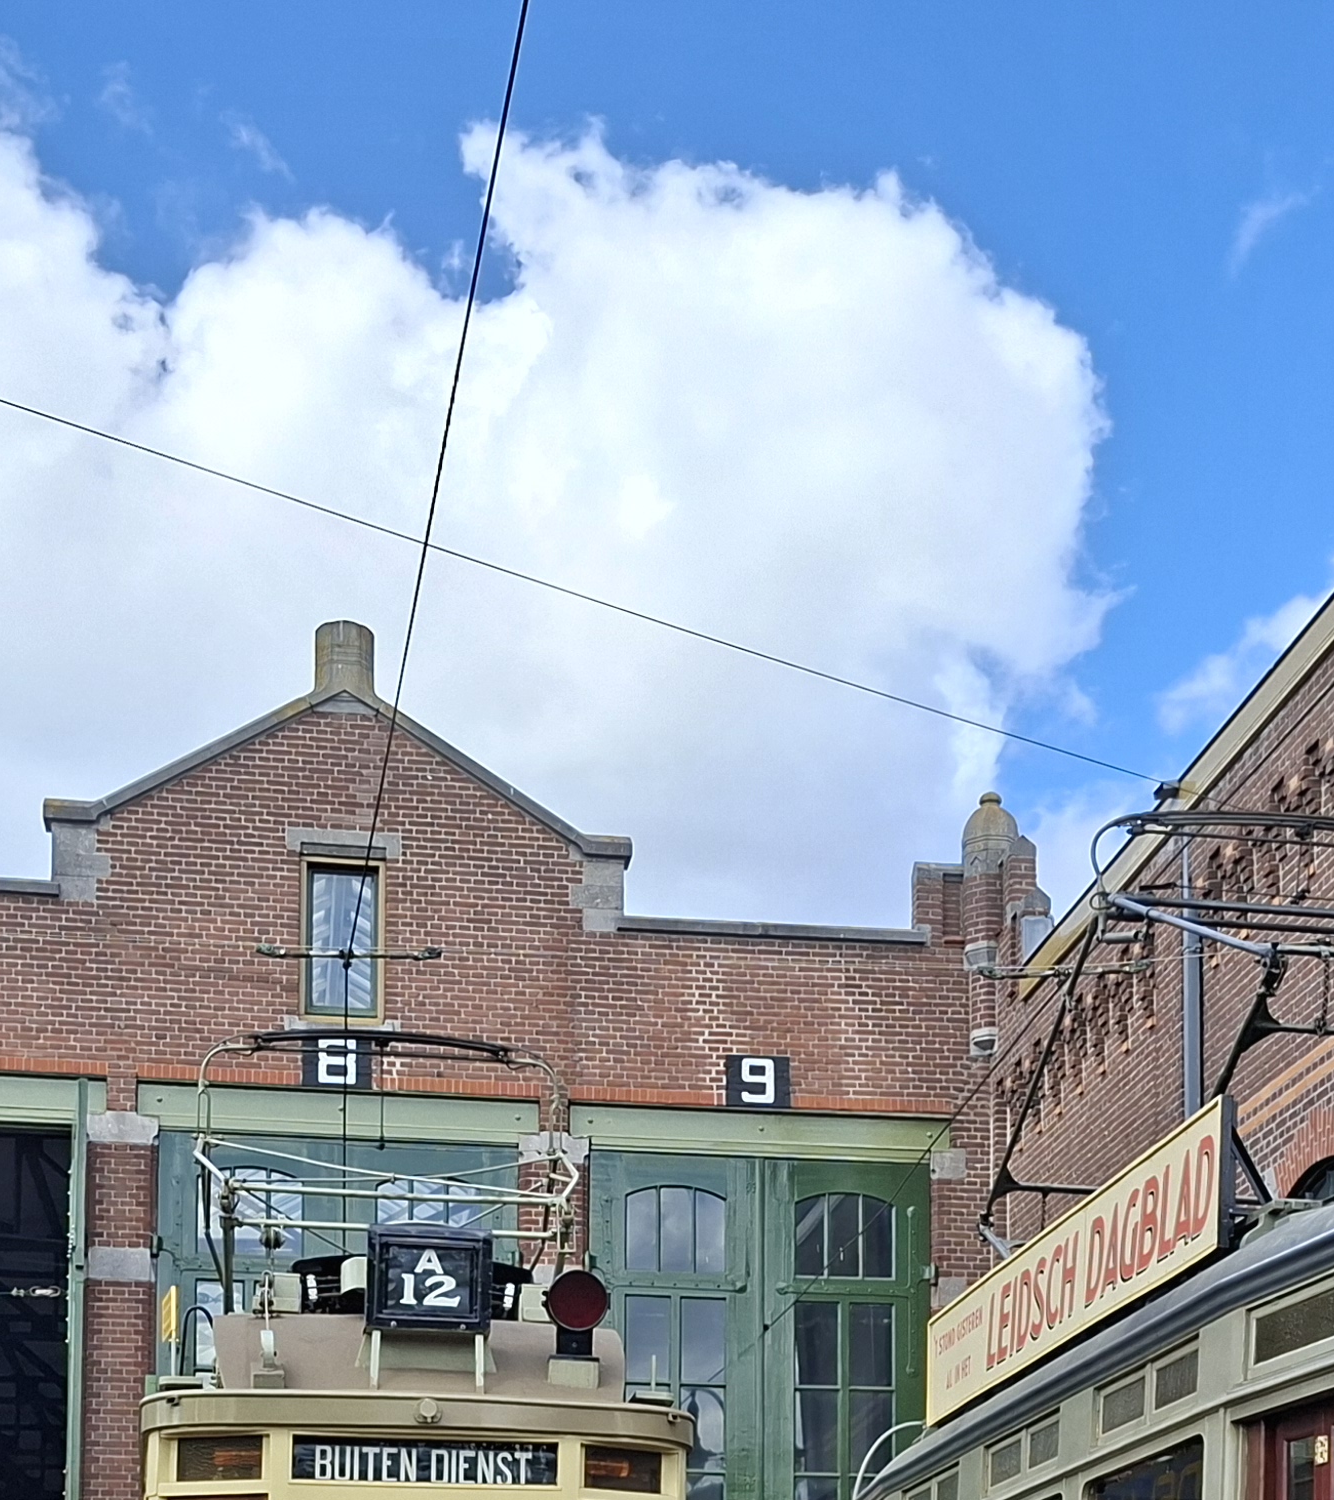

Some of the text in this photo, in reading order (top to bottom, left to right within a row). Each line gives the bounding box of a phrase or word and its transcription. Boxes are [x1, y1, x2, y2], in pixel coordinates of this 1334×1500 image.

[318, 1039, 356, 1085] 8
[741, 1057, 775, 1104] 9
[413, 1249, 445, 1275] A
[986, 1134, 1216, 1371] LEIDSCH DAGBLAD
[399, 1273, 462, 1308] 12
[314, 1444, 533, 1485] BUITEN DIENST
